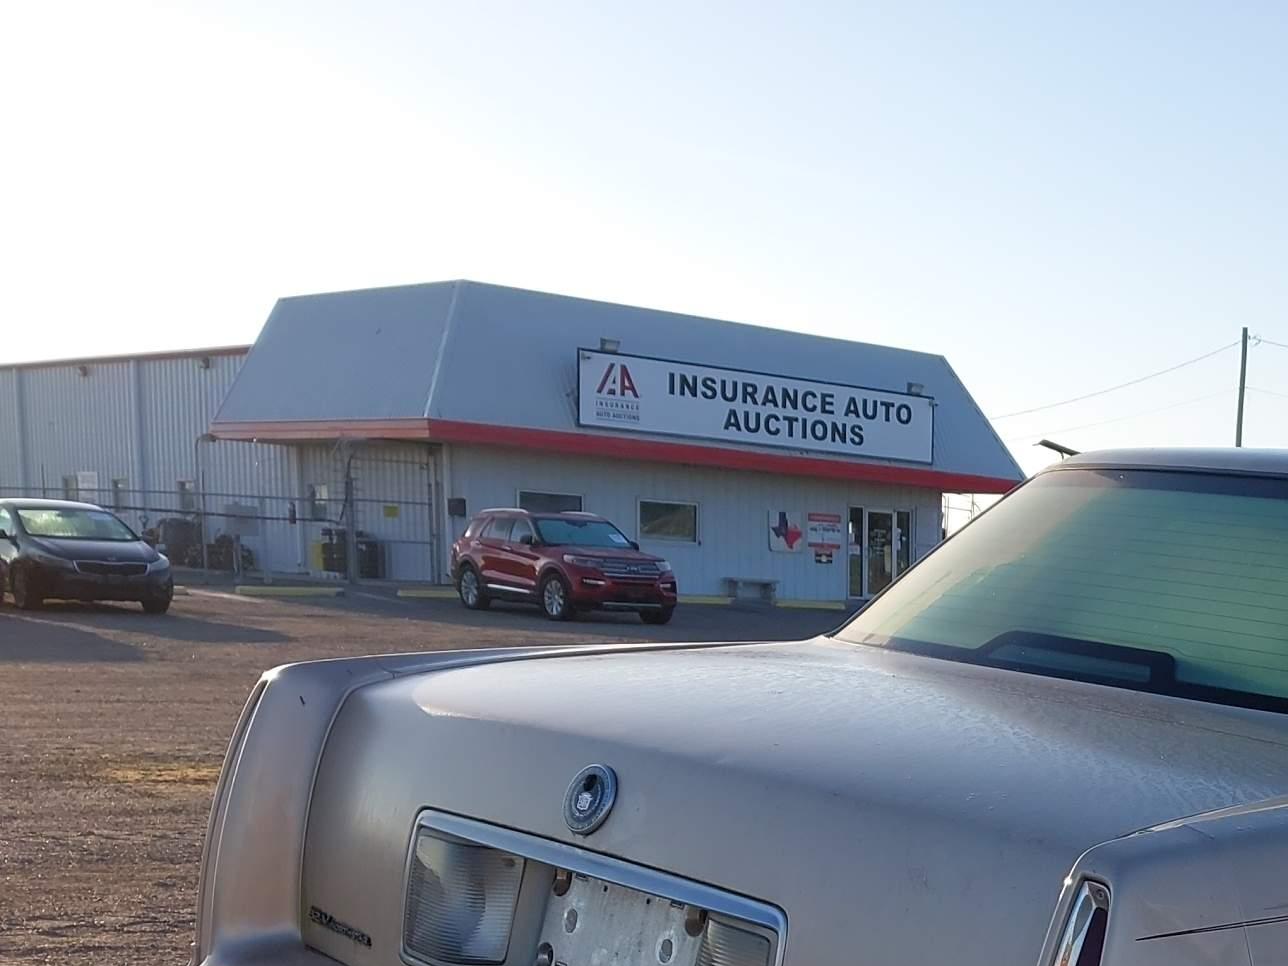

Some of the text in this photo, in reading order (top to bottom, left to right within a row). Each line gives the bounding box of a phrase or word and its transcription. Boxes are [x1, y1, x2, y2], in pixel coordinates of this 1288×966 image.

[668, 372, 912, 425] INSURANCE AUTO
[723, 408, 864, 446] AUCTIONS
